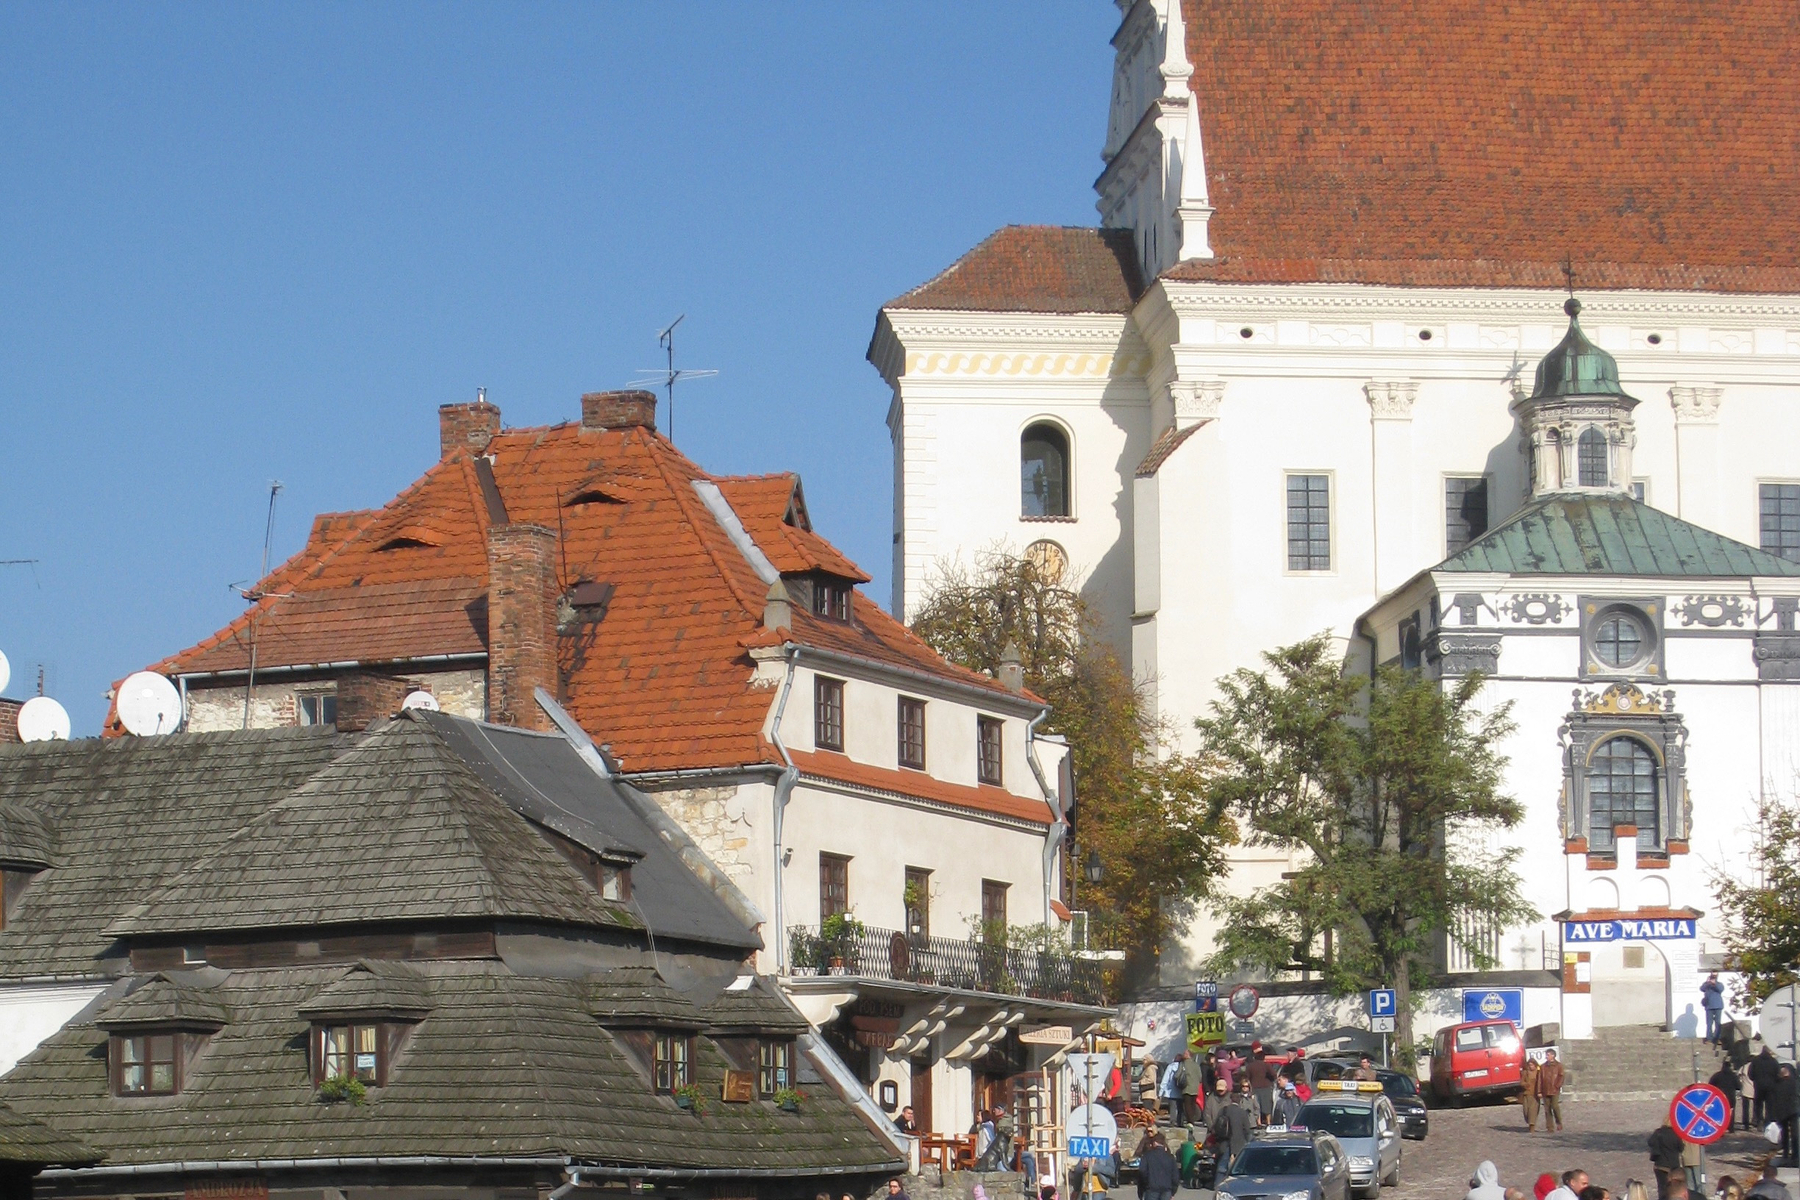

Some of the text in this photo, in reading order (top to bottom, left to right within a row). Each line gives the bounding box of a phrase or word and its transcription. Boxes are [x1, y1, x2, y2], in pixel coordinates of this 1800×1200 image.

[1571, 920, 1691, 939] AVE MARIA
[1196, 983, 1216, 994] FOTO
[1376, 992, 1390, 1013] P
[1048, 1029, 1071, 1039] SZTUKI
[1187, 1016, 1224, 1034] FOTO
[1071, 1138, 1107, 1156] TAXI
